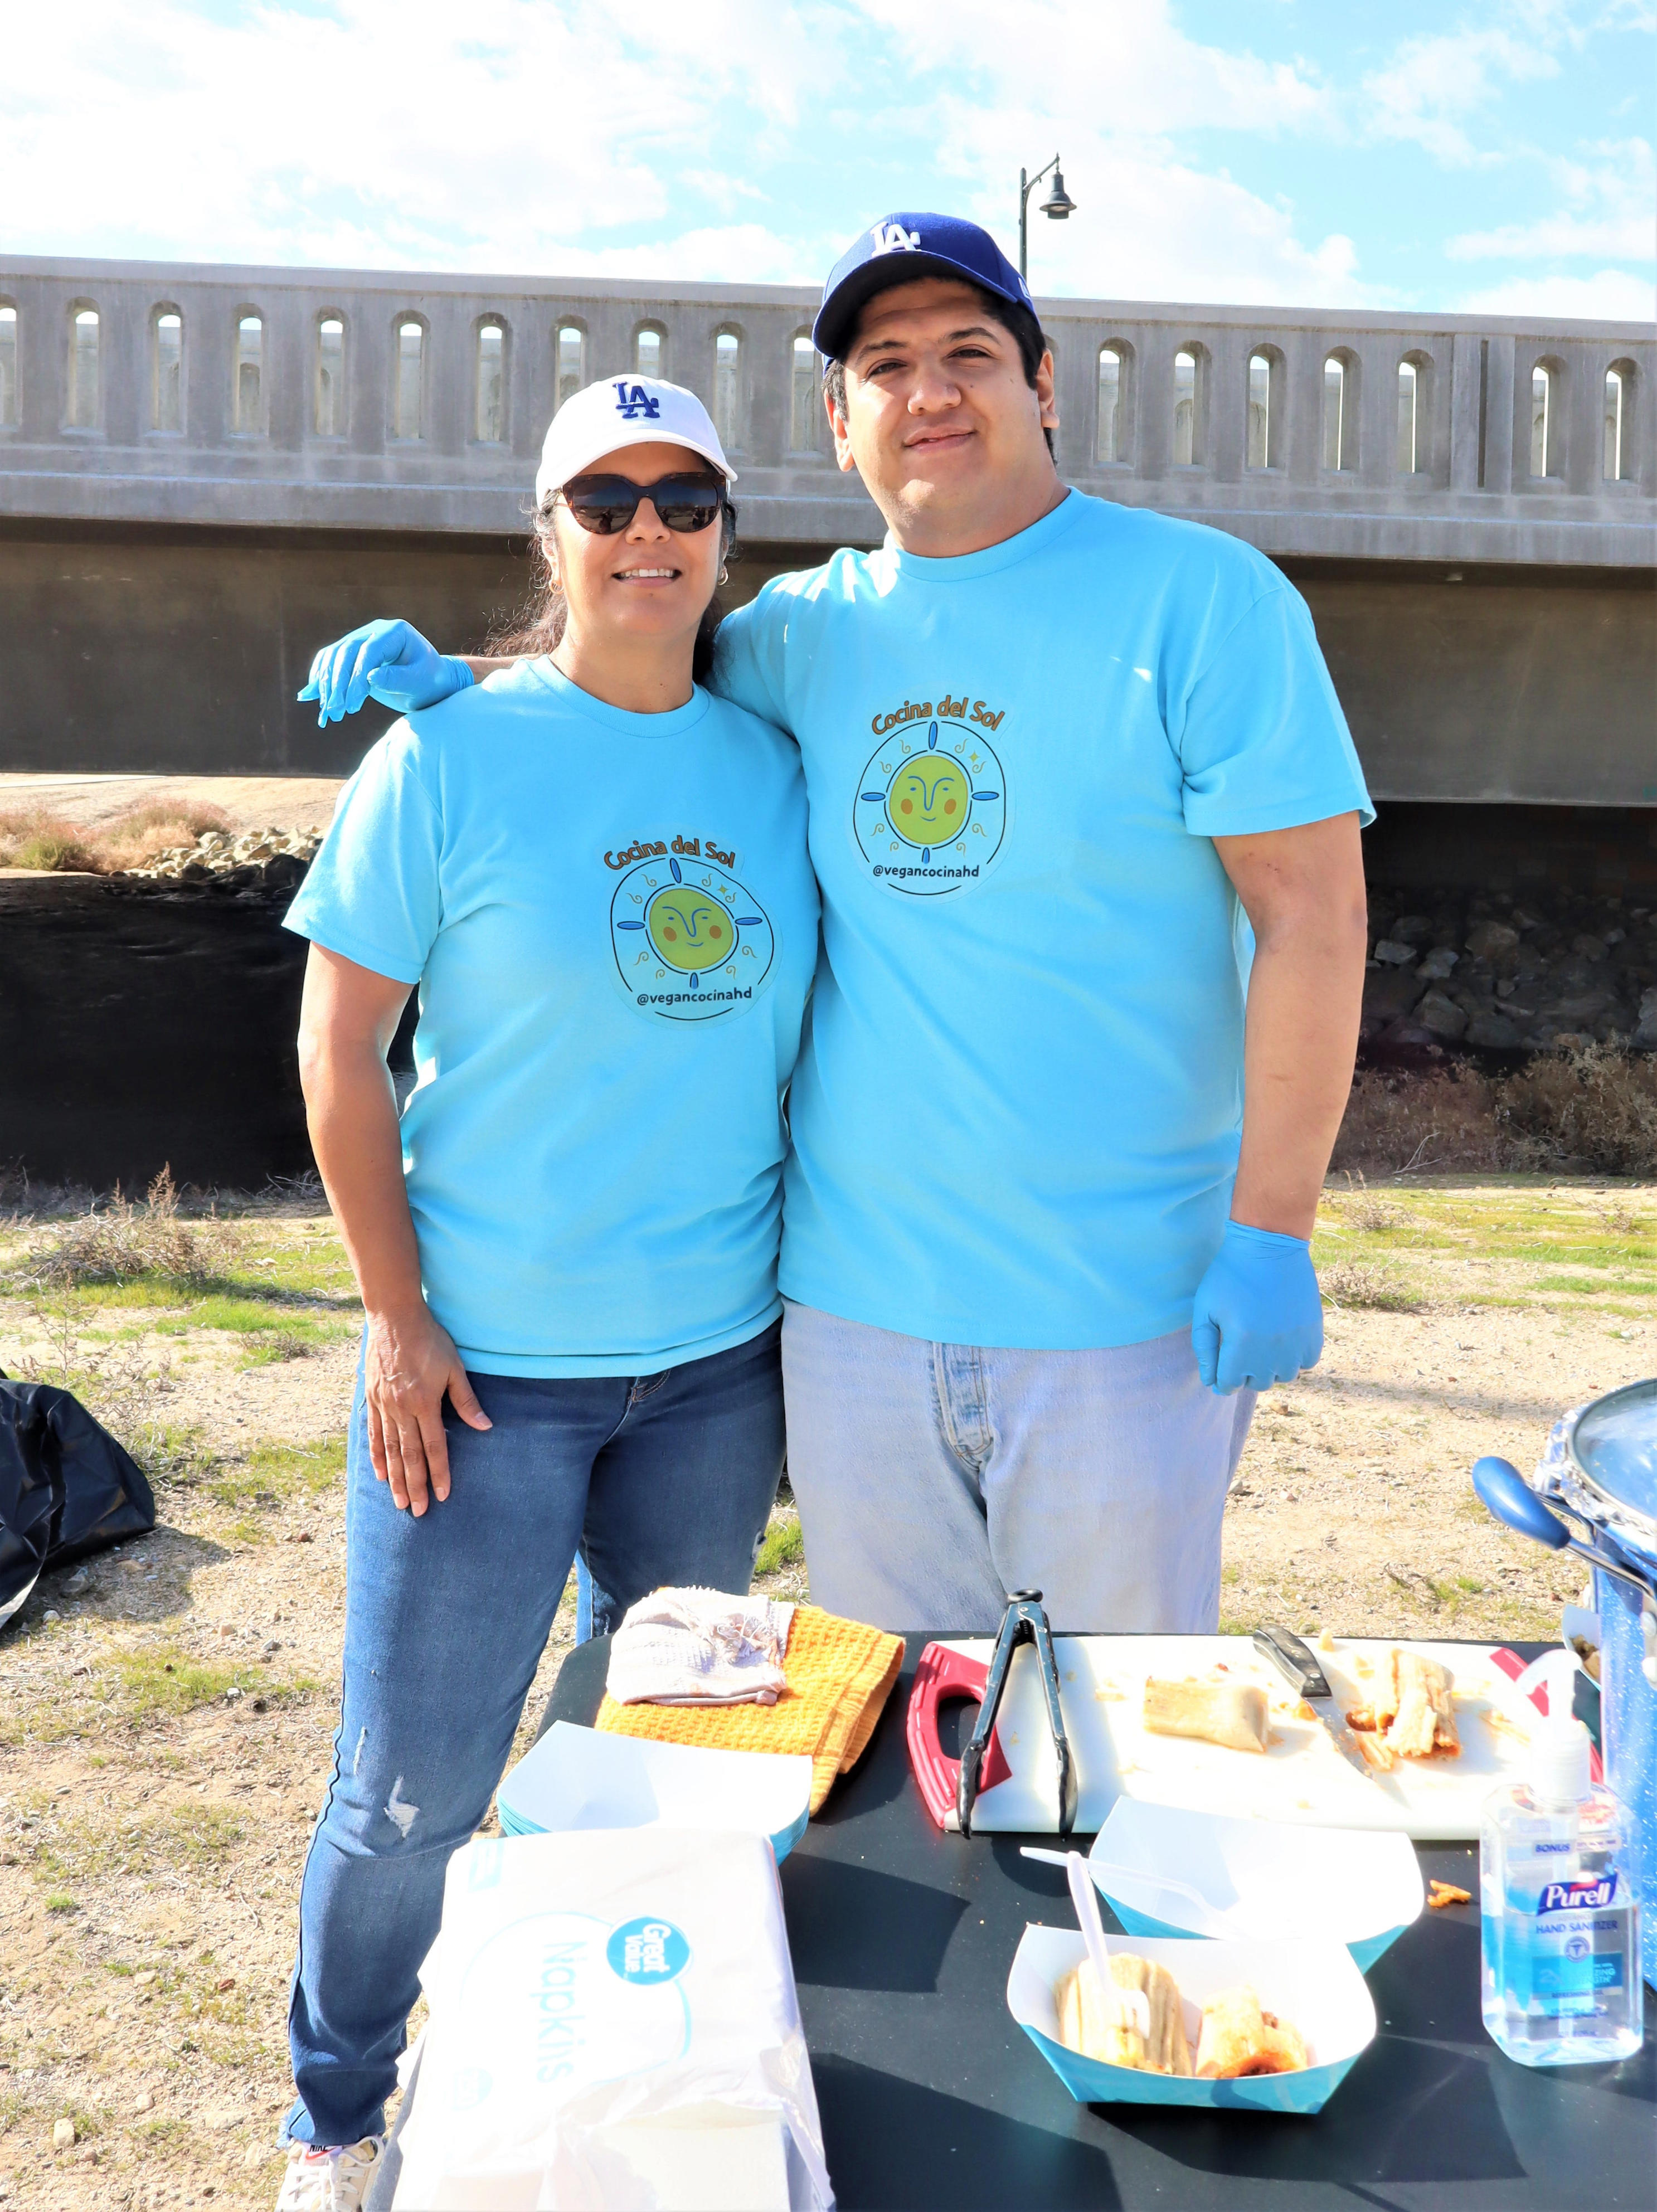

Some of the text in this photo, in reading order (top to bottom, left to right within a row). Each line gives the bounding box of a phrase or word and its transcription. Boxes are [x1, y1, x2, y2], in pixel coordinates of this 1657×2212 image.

[869, 221, 921, 257] LA
[612, 381, 660, 419] LA
[871, 694, 1005, 735] Cocina del Sol
[604, 835, 736, 871] Cocina del Sol
[873, 864, 979, 879] @vegancocinahd
[637, 986, 752, 1006] @vegancocinahd
[1535, 1844, 1570, 1853] BONUS
[1546, 1882, 1611, 1908] Purell
[1535, 1920, 1618, 1934] HAND SANITIZER
[624, 1934, 645, 1973] Value
[642, 1923, 672, 1973] Great
